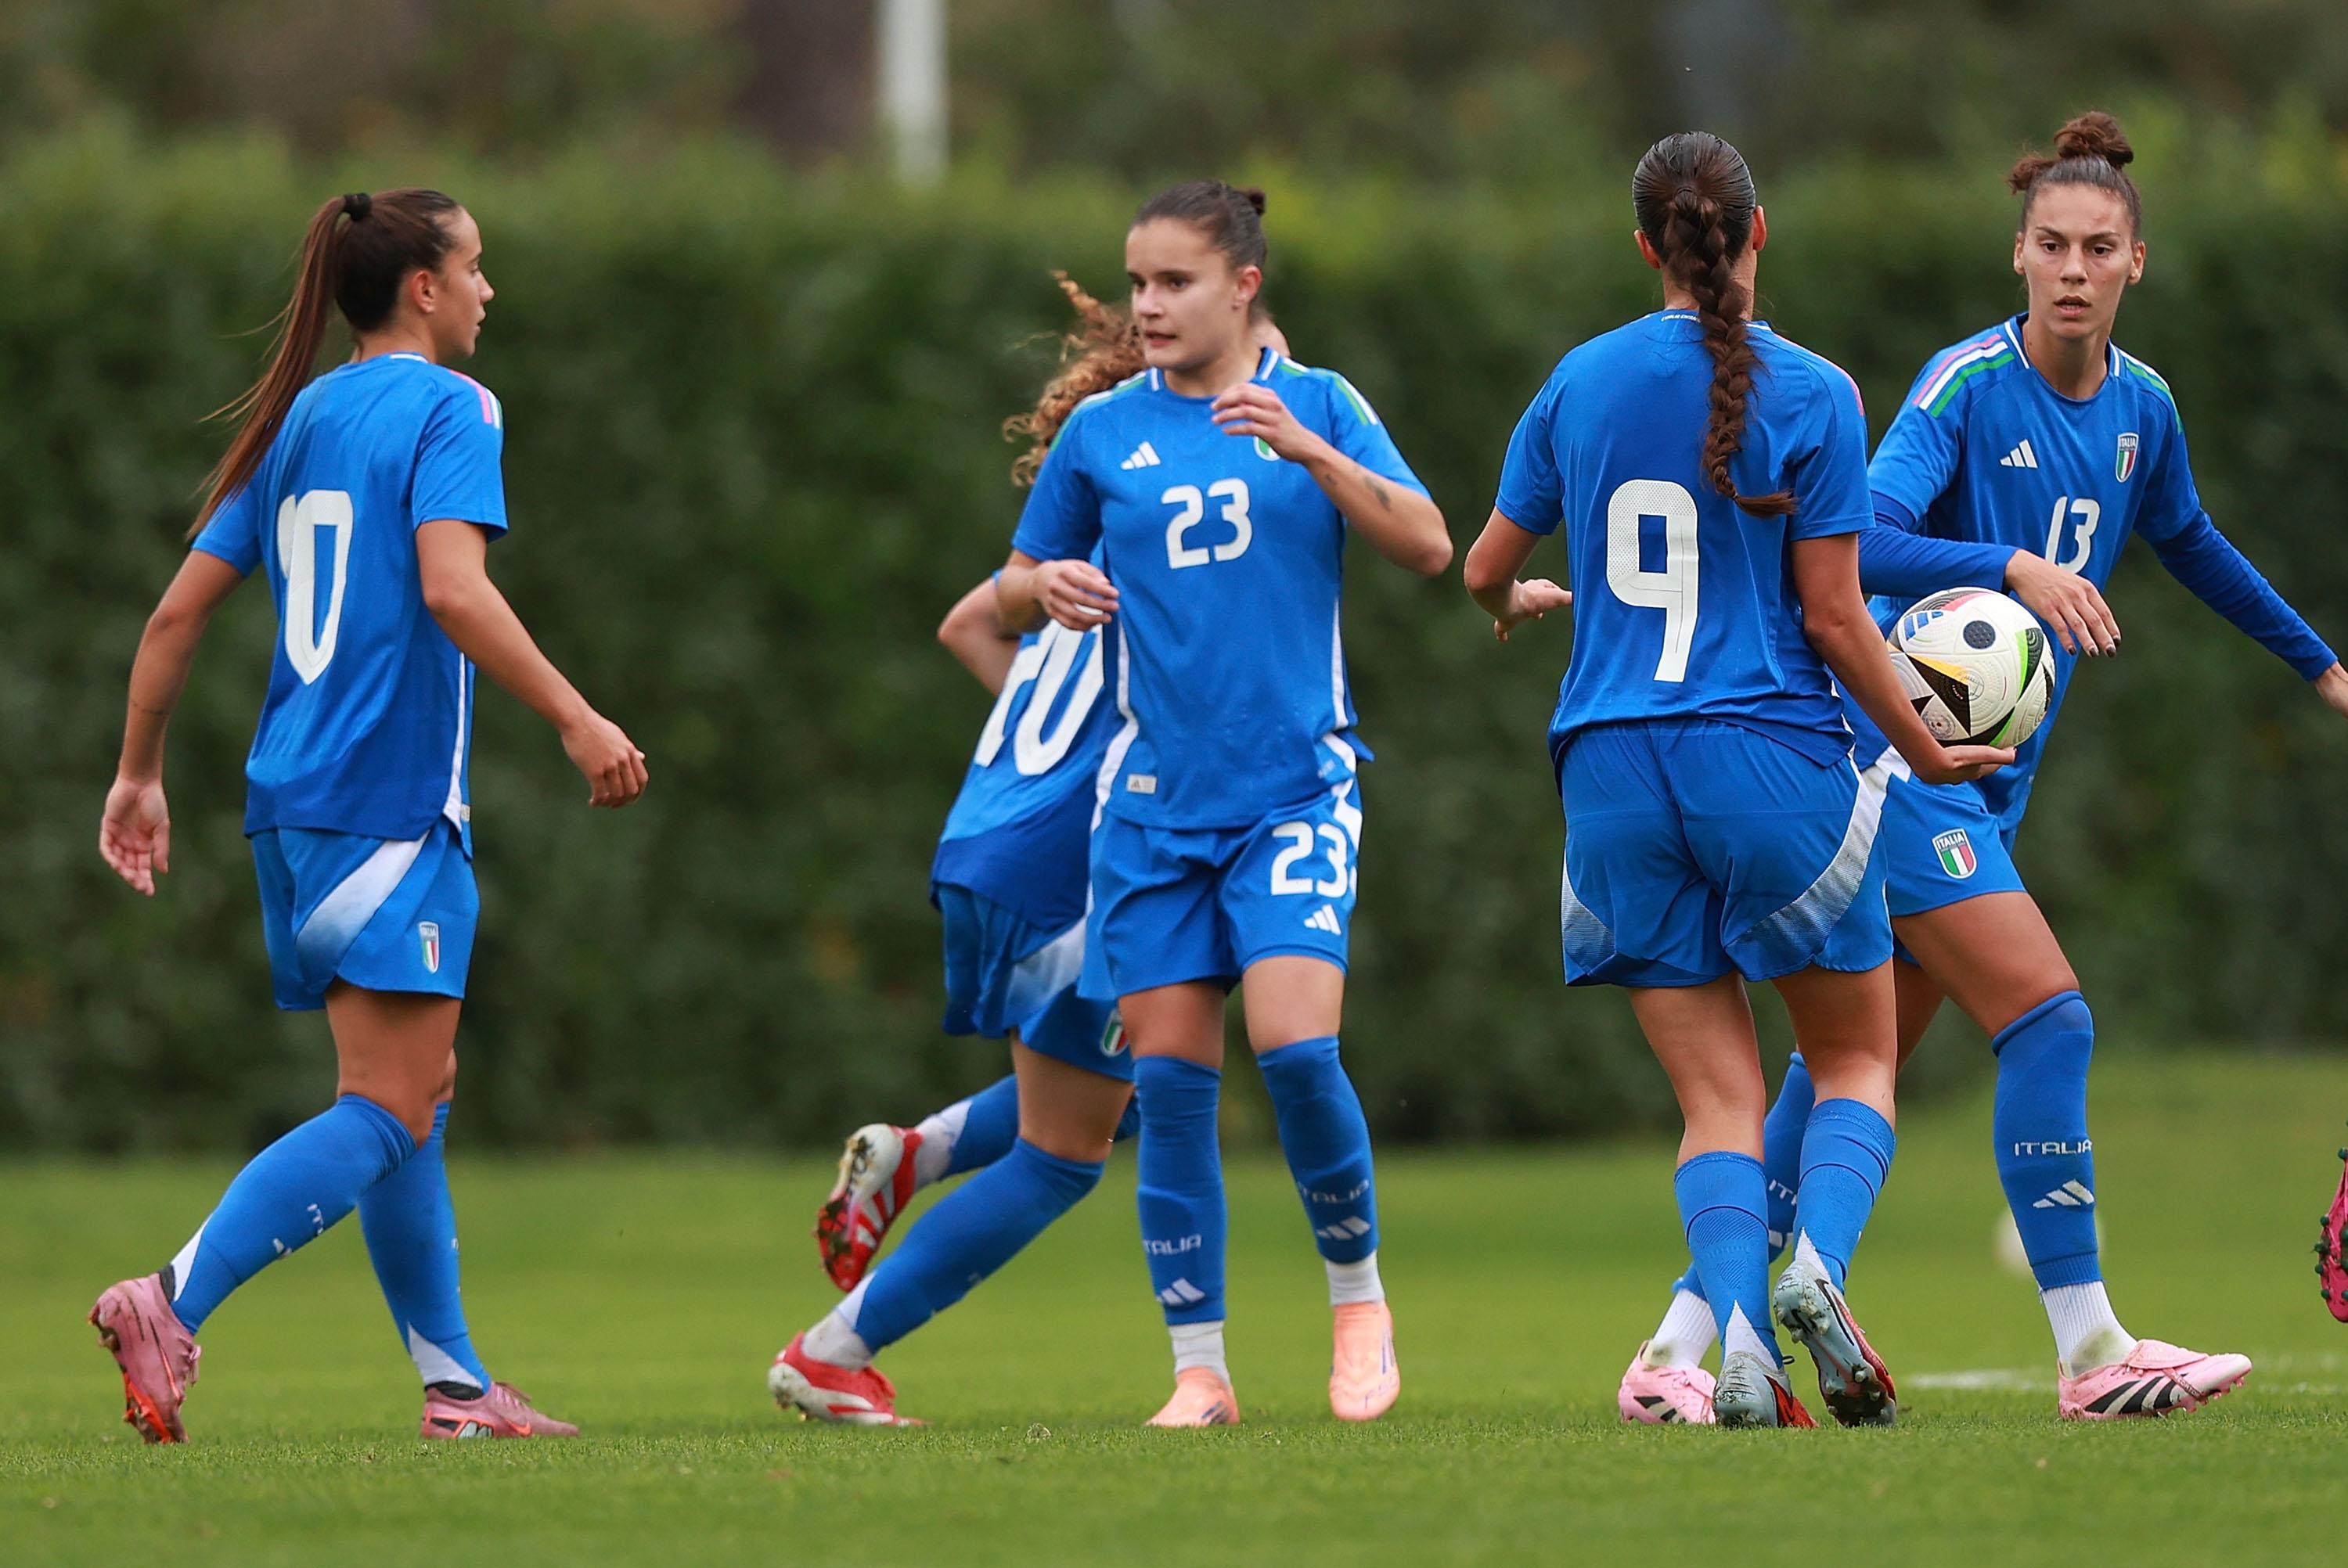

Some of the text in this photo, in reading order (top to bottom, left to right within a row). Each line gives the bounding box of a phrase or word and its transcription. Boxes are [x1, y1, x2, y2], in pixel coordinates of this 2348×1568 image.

[1161, 477, 1252, 570] 23
[2045, 495, 2101, 574] 13
[1607, 479, 1699, 682] 9
[1271, 822, 1348, 897] 23
[1936, 832, 1966, 851] ITALIA
[2015, 1139, 2092, 1156] ITALIA
